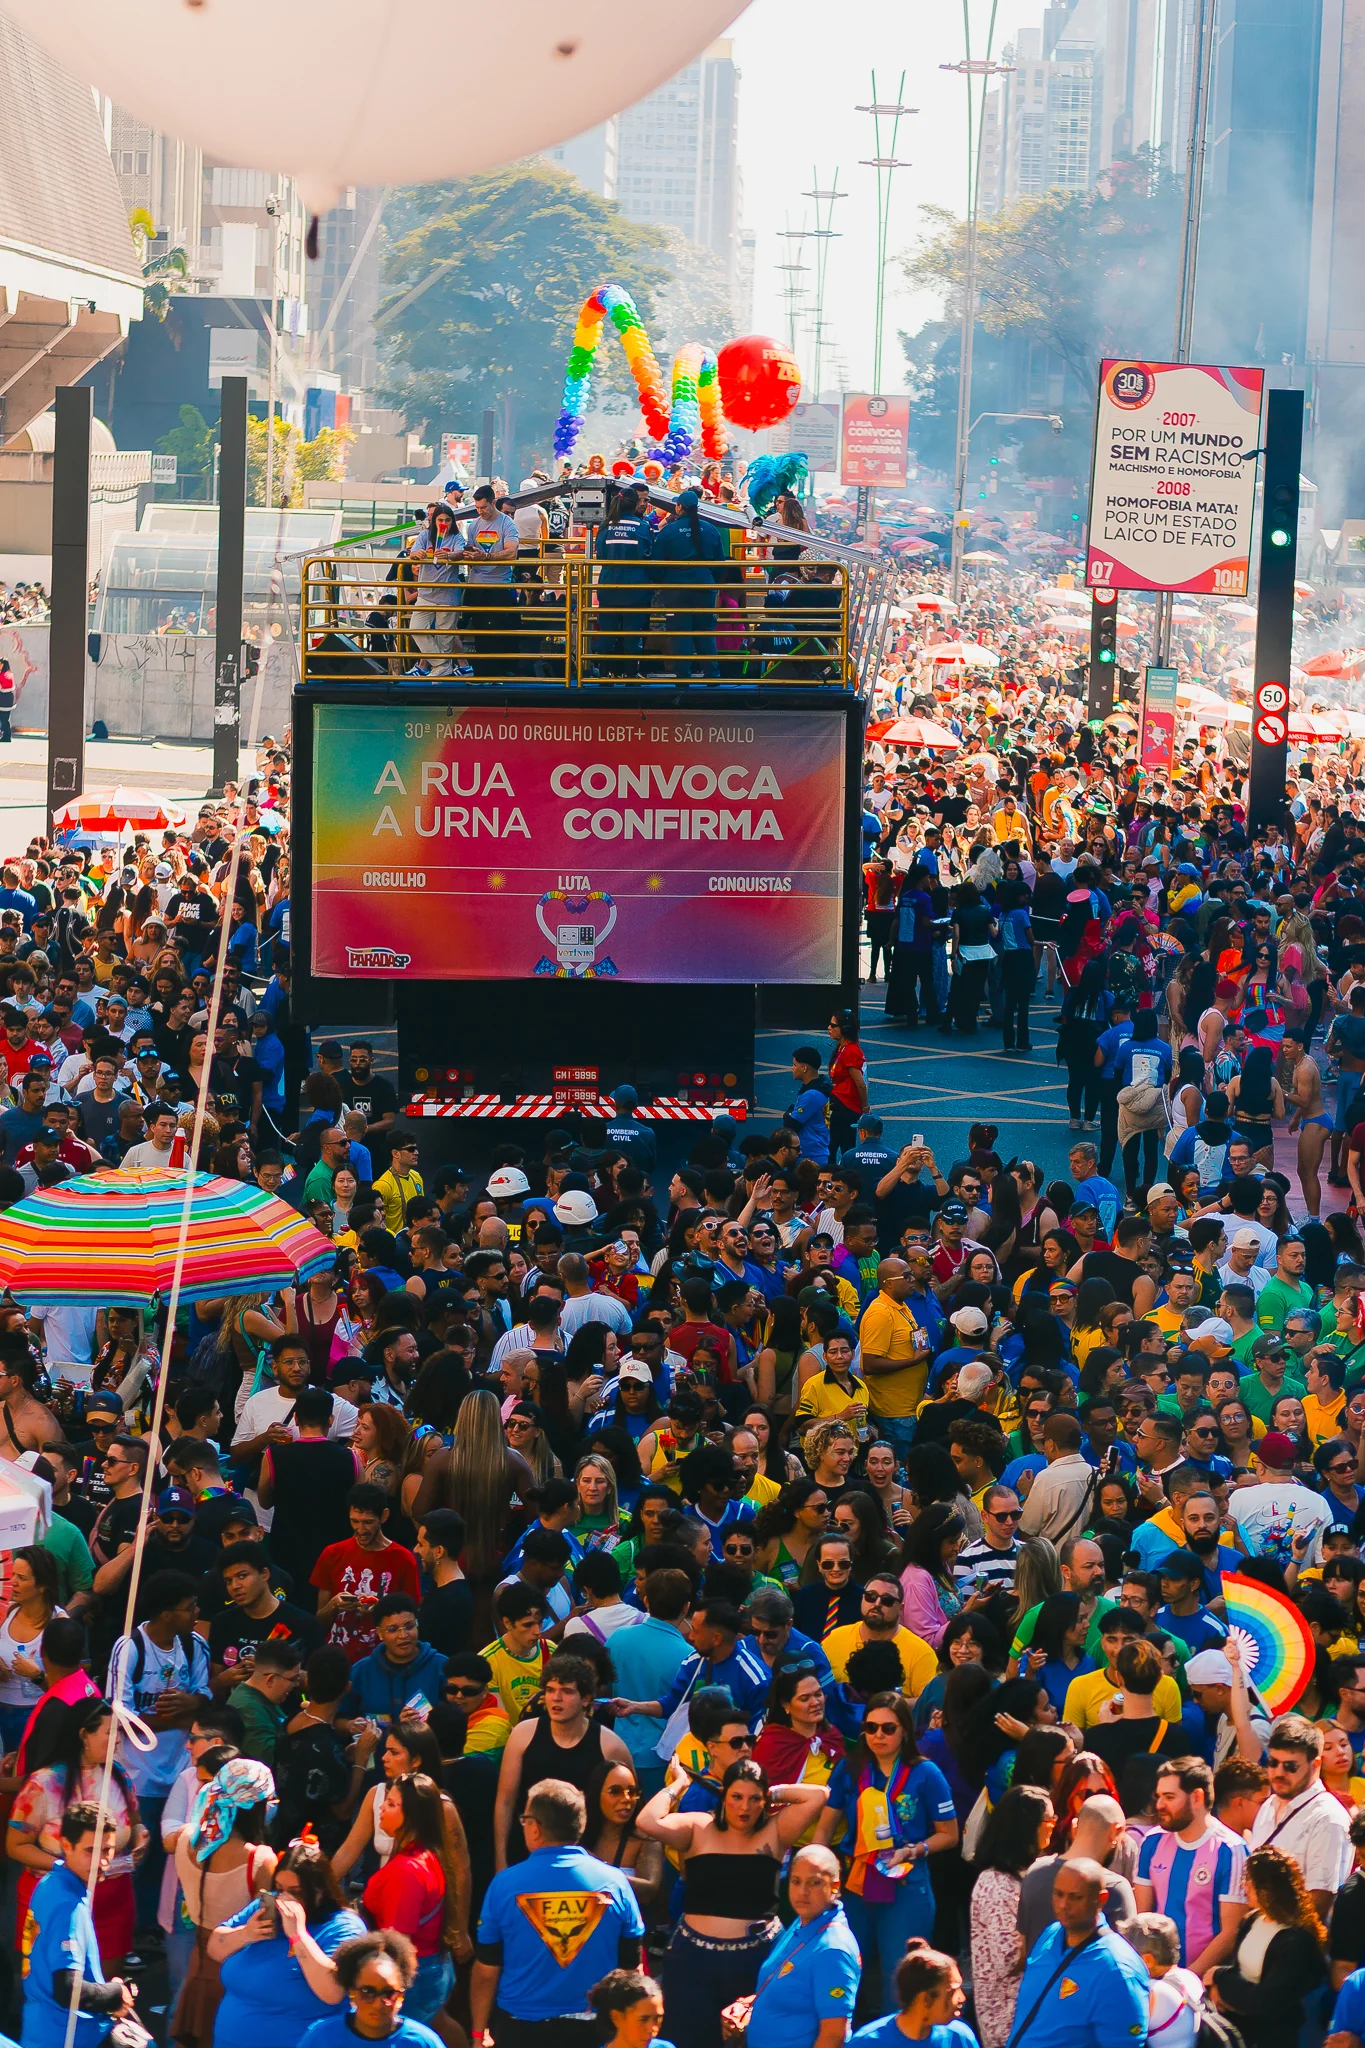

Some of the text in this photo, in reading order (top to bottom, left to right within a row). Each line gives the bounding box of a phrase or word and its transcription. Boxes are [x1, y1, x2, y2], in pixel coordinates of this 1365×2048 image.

[1117, 373, 1137, 389] 30
[1163, 412, 1196, 427] 2007
[848, 427, 902, 438] CONVOCA
[1111, 428, 1243, 448] POR UM MUNDO
[848, 445, 902, 454] CONFIRMA
[1110, 445, 1245, 469] SEM RACISMO,
[1109, 463, 1242, 479] MACHISMO E HOMOFOBIA
[1156, 481, 1191, 496] 2008
[1107, 496, 1239, 514] HOMOFOBIA MATA!
[1105, 510, 1237, 531] POR UM ESTADO
[1104, 527, 1236, 548] LAICO DE FATO
[1091, 561, 1114, 580] 07
[1213, 568, 1245, 589] 10H
[1263, 690, 1282, 702] 50
[404, 722, 755, 743] 30ª PARADA DO ORGULHO LGBT+ DE SÃO PAULO
[373, 761, 784, 800] A RUA CONVOCA
[372, 805, 784, 841] A URNA CONFIRMA
[362, 872, 792, 892] ORGULHO LUTA CONQUISTAS
[179, 902, 201, 910] PEACE
[542, 1900, 588, 1914] F.A.V
